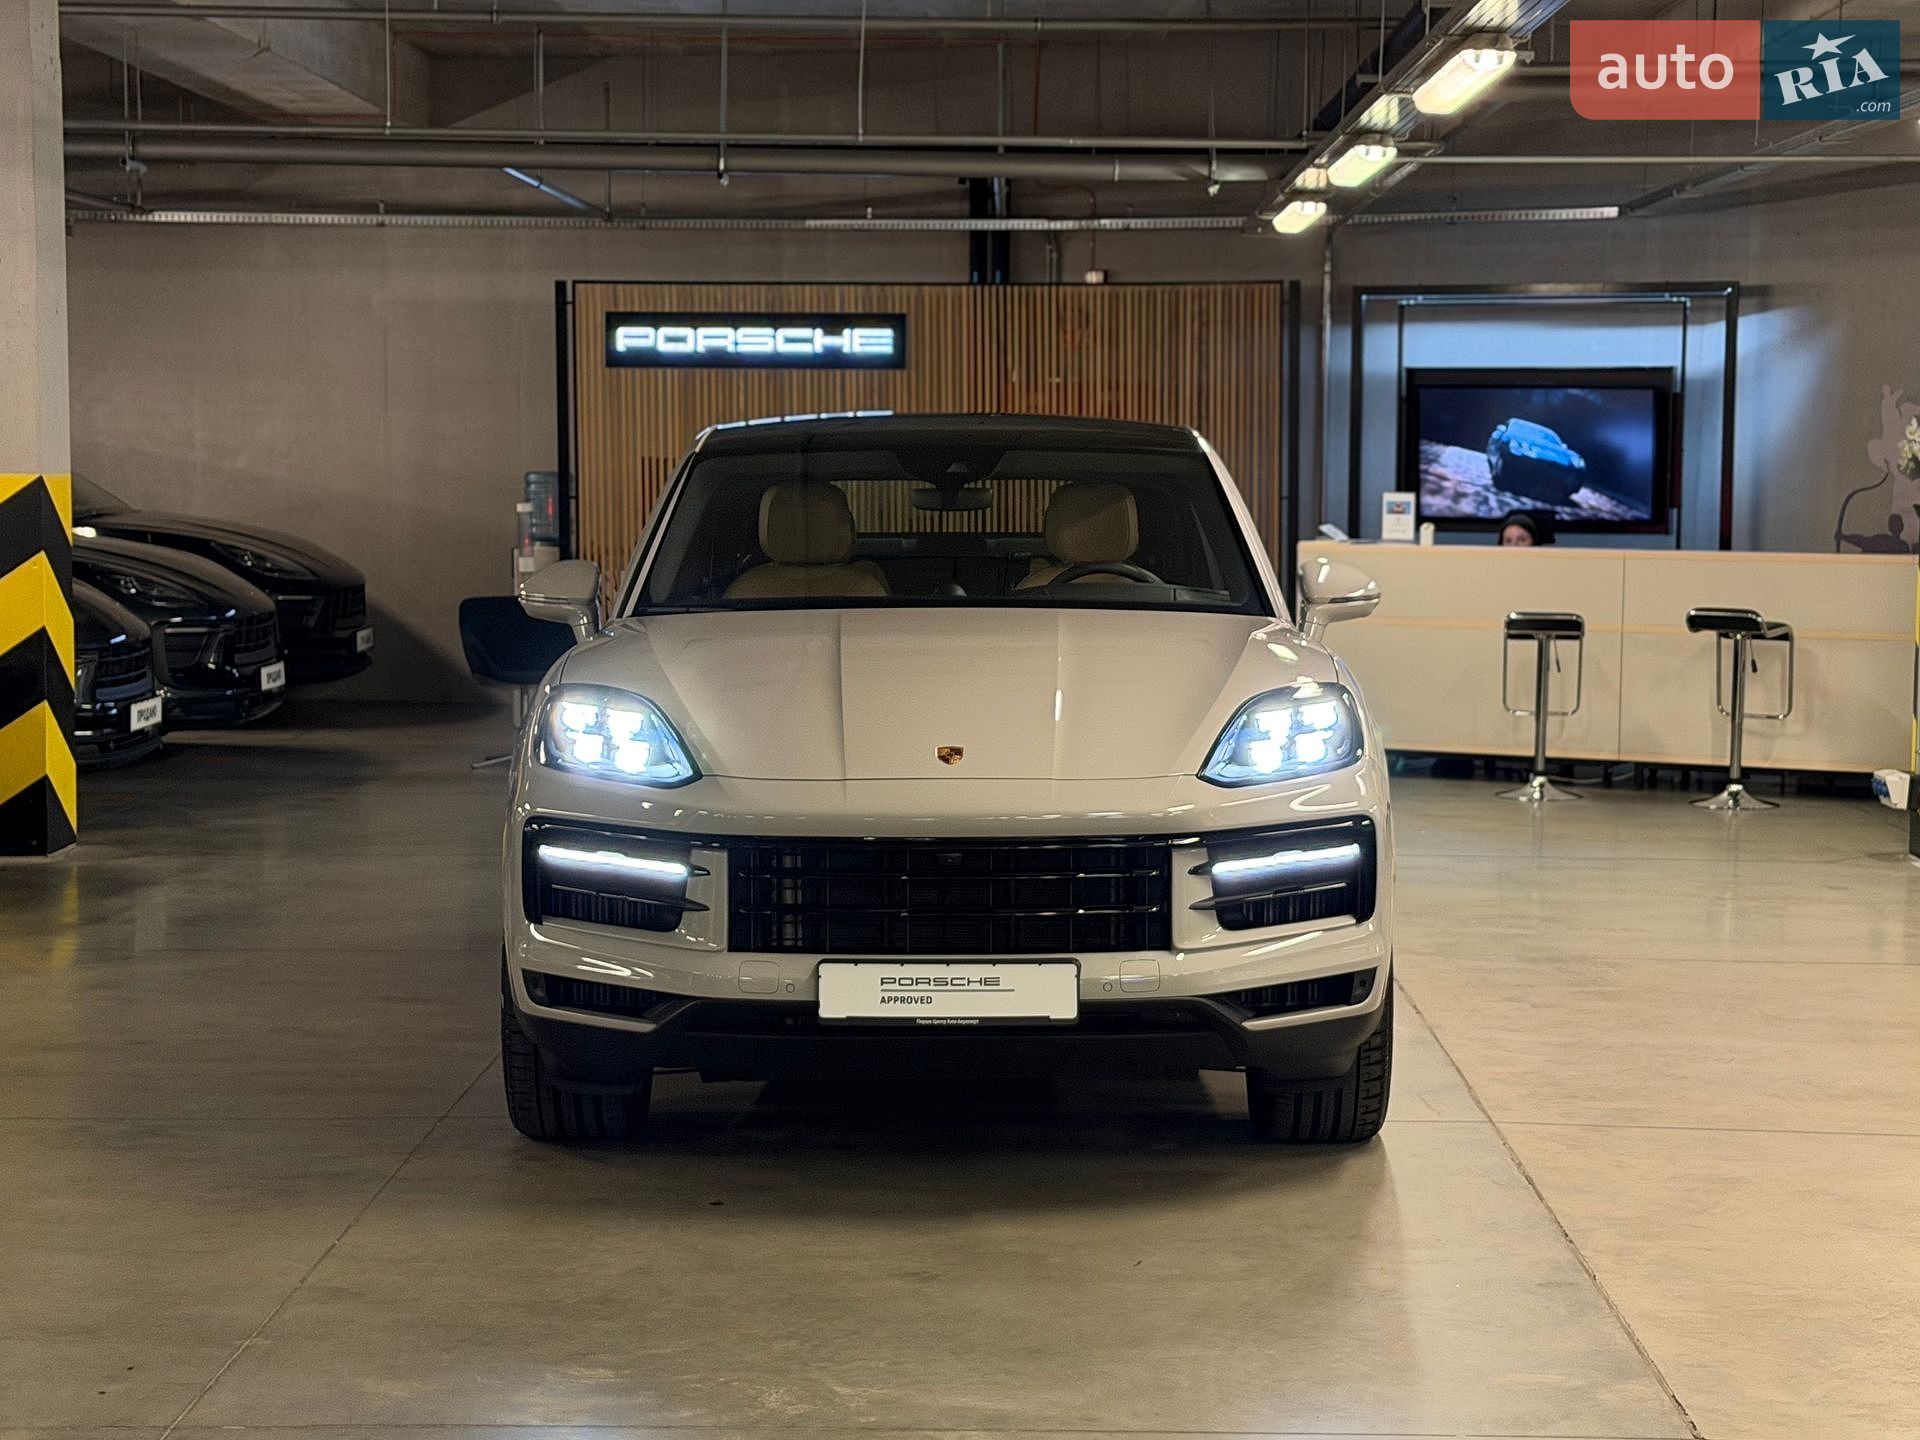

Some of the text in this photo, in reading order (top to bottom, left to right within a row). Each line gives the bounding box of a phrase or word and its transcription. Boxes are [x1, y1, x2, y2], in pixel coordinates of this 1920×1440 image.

[615, 326, 894, 354] PORSCHE
[880, 976, 1001, 987] PORSCHE
[879, 995, 933, 1005] APPROVED
